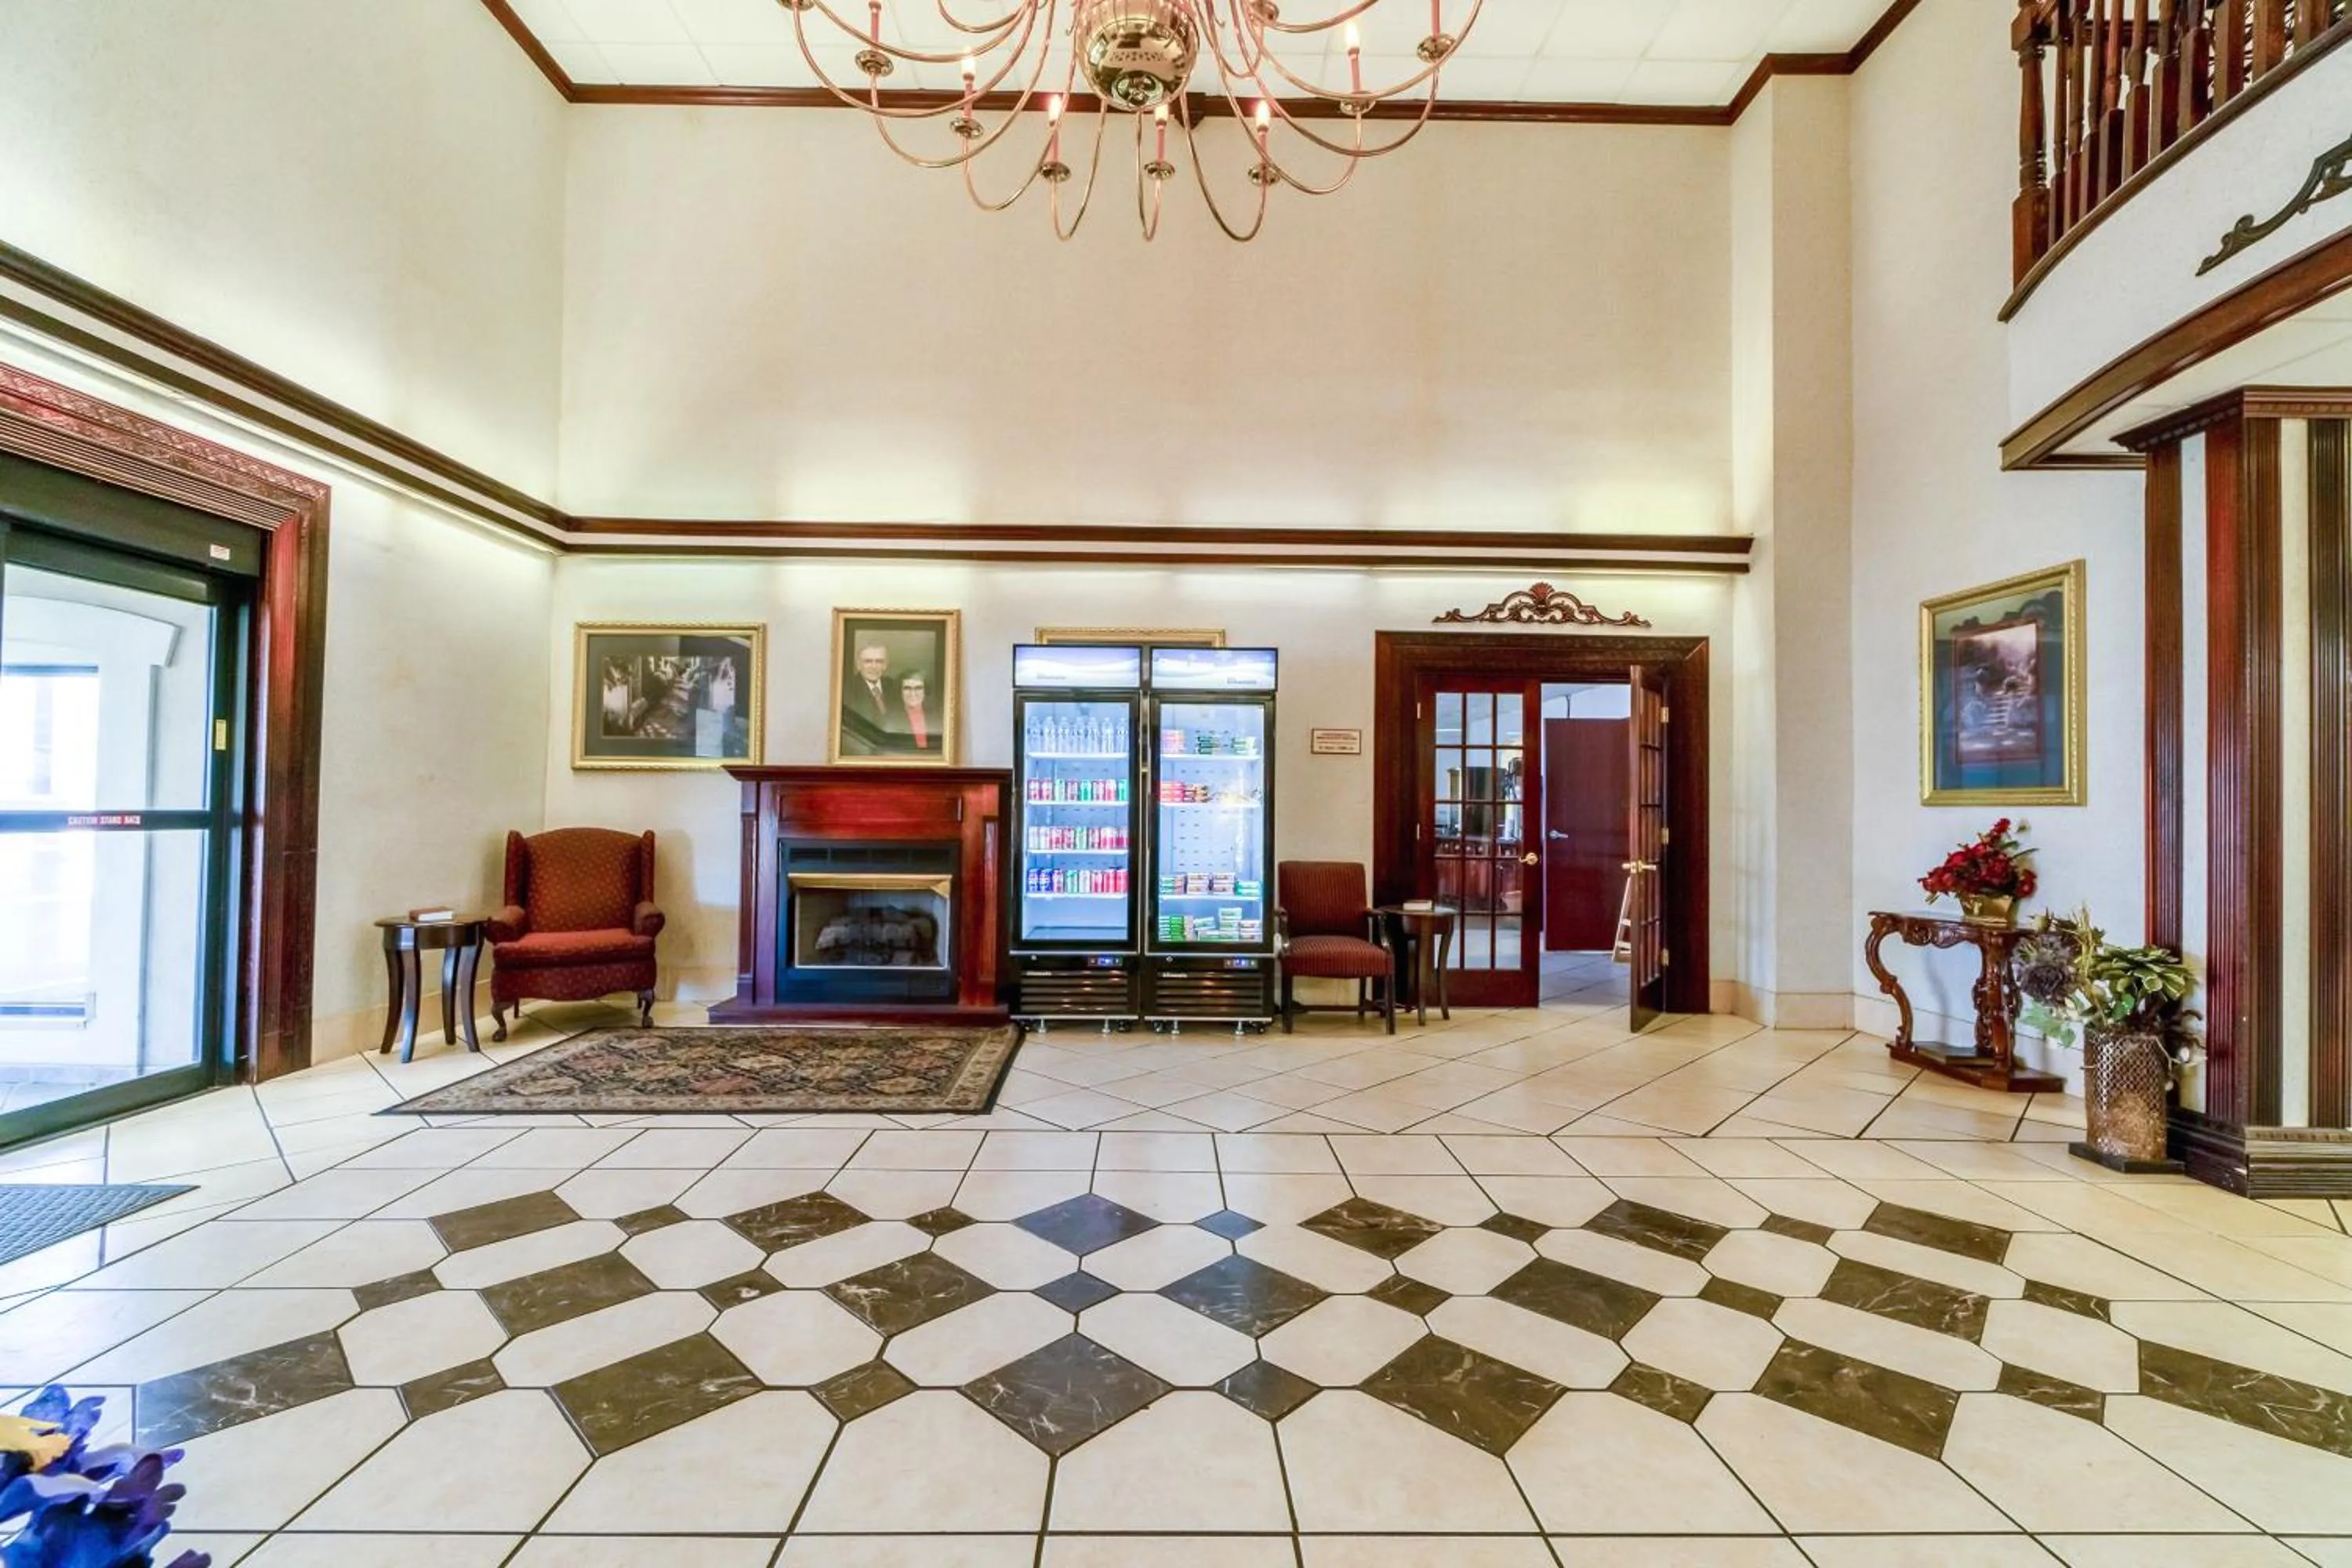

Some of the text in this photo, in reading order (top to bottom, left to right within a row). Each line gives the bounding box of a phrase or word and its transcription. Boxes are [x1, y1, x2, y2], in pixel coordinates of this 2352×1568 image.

[68, 815, 140, 825] CAUTION STAND BACK
